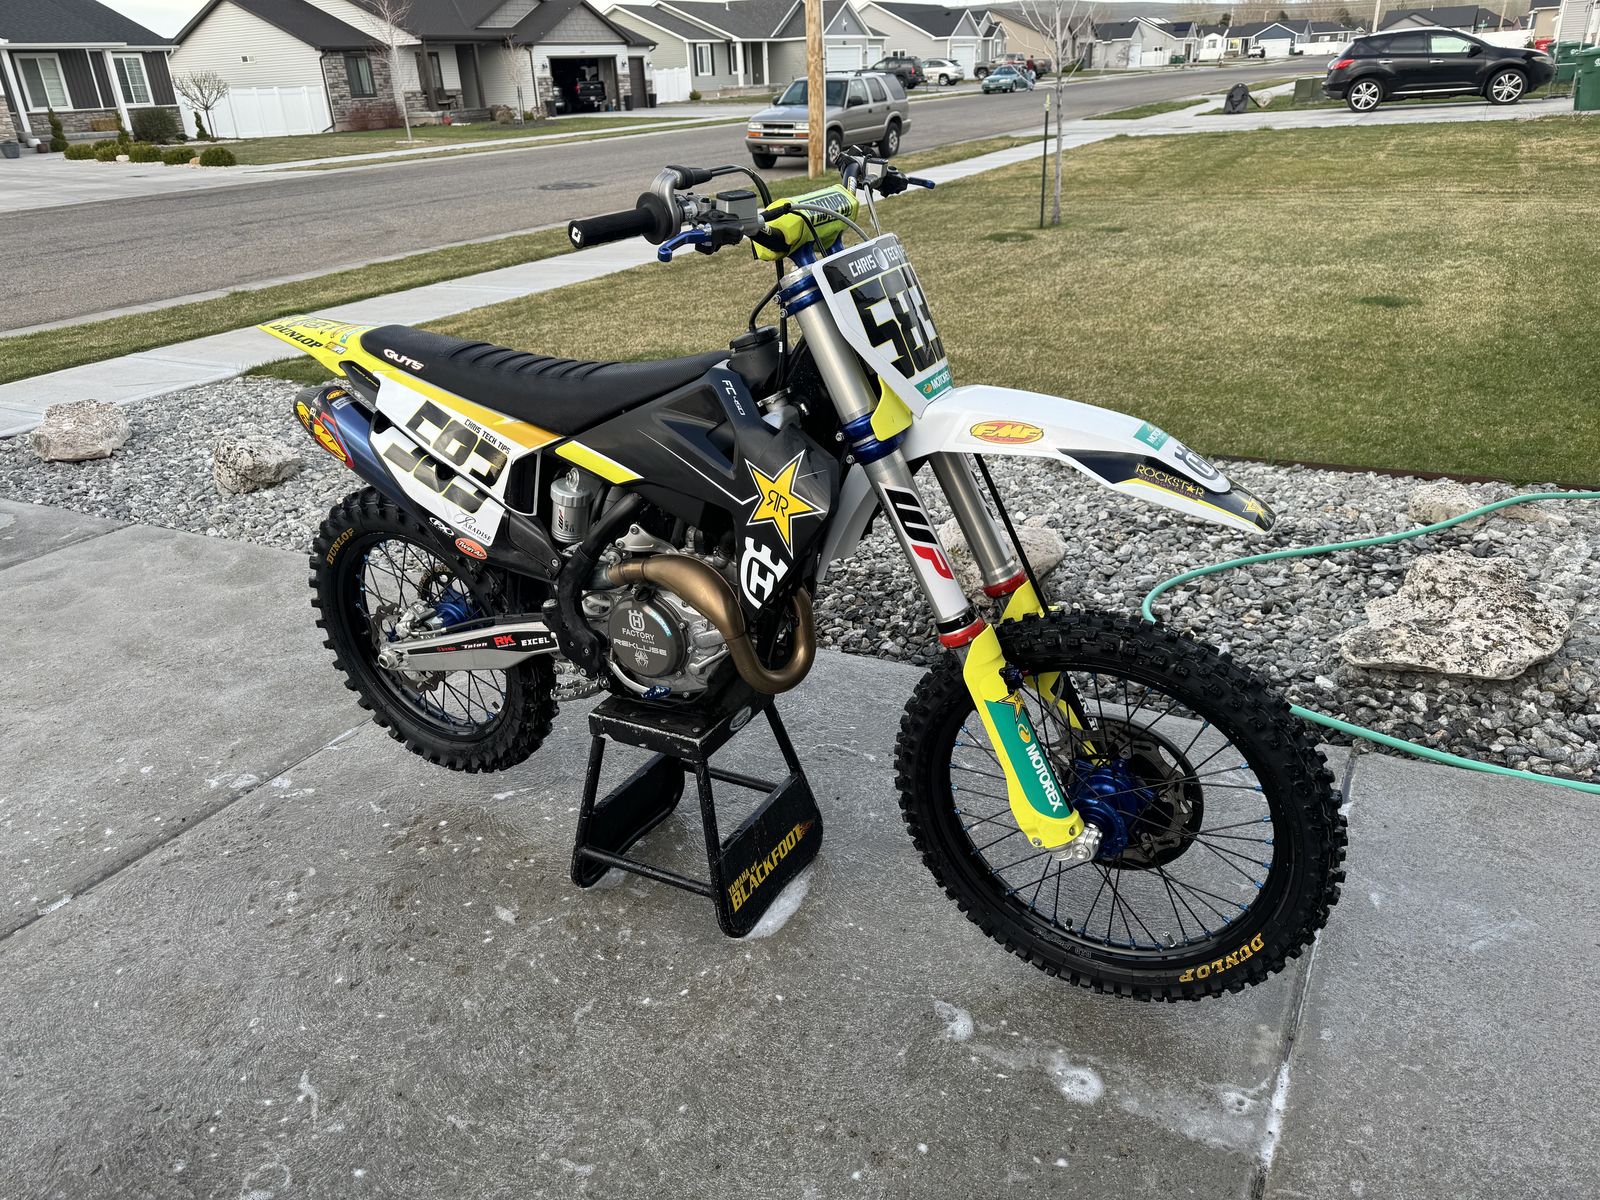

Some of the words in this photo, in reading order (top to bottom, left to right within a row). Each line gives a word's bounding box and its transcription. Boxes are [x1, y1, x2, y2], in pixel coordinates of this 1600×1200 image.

[848, 254, 877, 278] CHRIS
[270, 324, 324, 348] DUNLOP
[383, 348, 425, 371] GUTS
[721, 379, 737, 396] FC
[464, 418, 482, 435] CHRIS
[482, 430, 498, 447] TECH
[497, 441, 512, 455] TIPS
[972, 424, 1042, 439] FMF
[326, 527, 355, 566] DUNLOP
[494, 634, 516, 646] RK
[521, 637, 550, 647] EXCEL
[621, 627, 655, 641] FACTORY
[613, 638, 668, 657] REKLUSE
[1025, 742, 1064, 813] MOTOREX
[730, 823, 803, 913] BLACKFOOT
[728, 868, 751, 896] YAMAHA
[1179, 932, 1265, 983] DUNLOP
